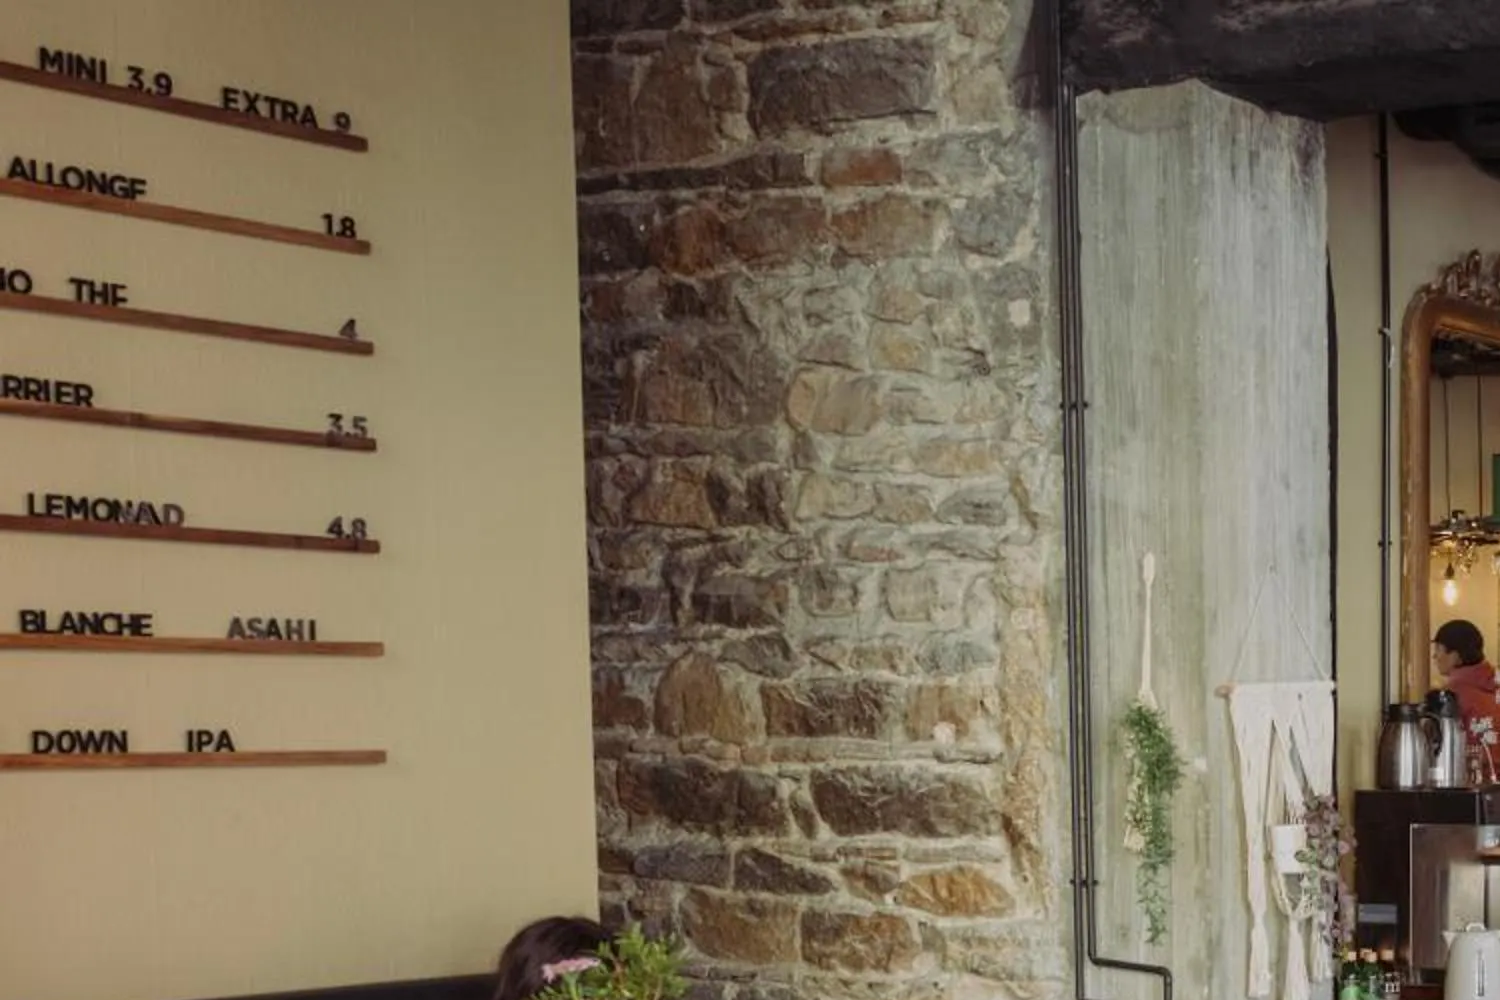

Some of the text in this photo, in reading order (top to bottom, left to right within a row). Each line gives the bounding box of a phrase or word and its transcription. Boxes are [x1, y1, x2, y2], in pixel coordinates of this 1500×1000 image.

[38, 46, 107, 84] MINI
[126, 65, 173, 98] 3.9
[220, 86, 319, 130] EXTRA
[338, 317, 357, 339] 4
[19, 609, 317, 642] BLANCHE ASAHI
[31, 728, 236, 755] DOWN IPA
